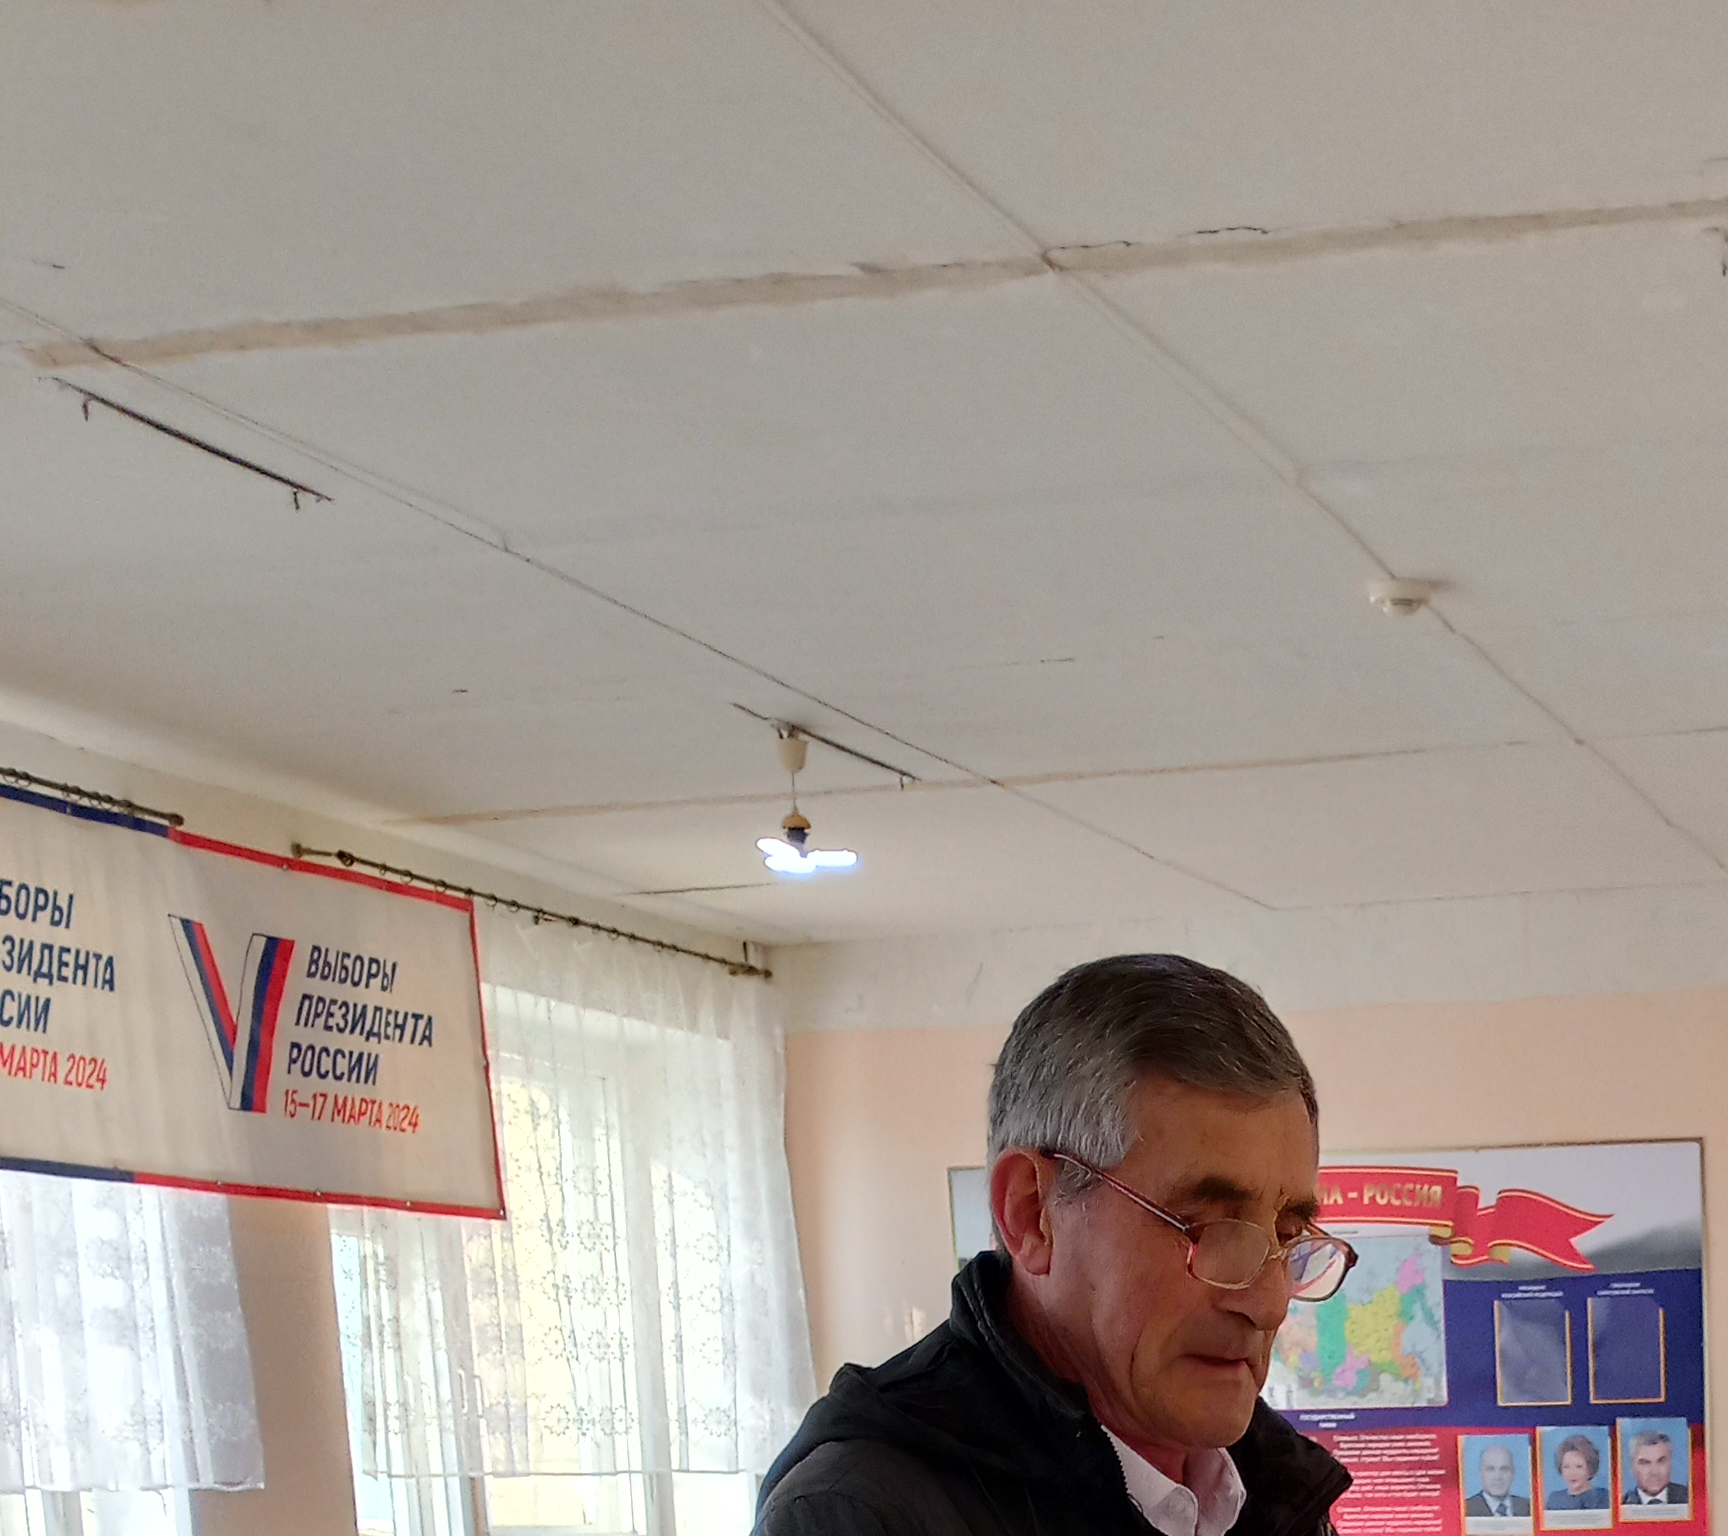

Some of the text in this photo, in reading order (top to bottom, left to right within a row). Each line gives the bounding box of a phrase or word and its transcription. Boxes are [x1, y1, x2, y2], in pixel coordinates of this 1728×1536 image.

[2, 934, 115, 992] ЗИДЕНТА
[306, 944, 398, 993] ВЫБОРЫ
[295, 993, 433, 1047] ПРЕЗИДЕНТА
[64, 1053, 107, 1091] 2024
[287, 1041, 379, 1086] РОССИИ
[331, 1093, 384, 1129] МАРТА
[385, 1101, 420, 1134] 2024
[1363, 1183, 1443, 1207] РОССИЯ
